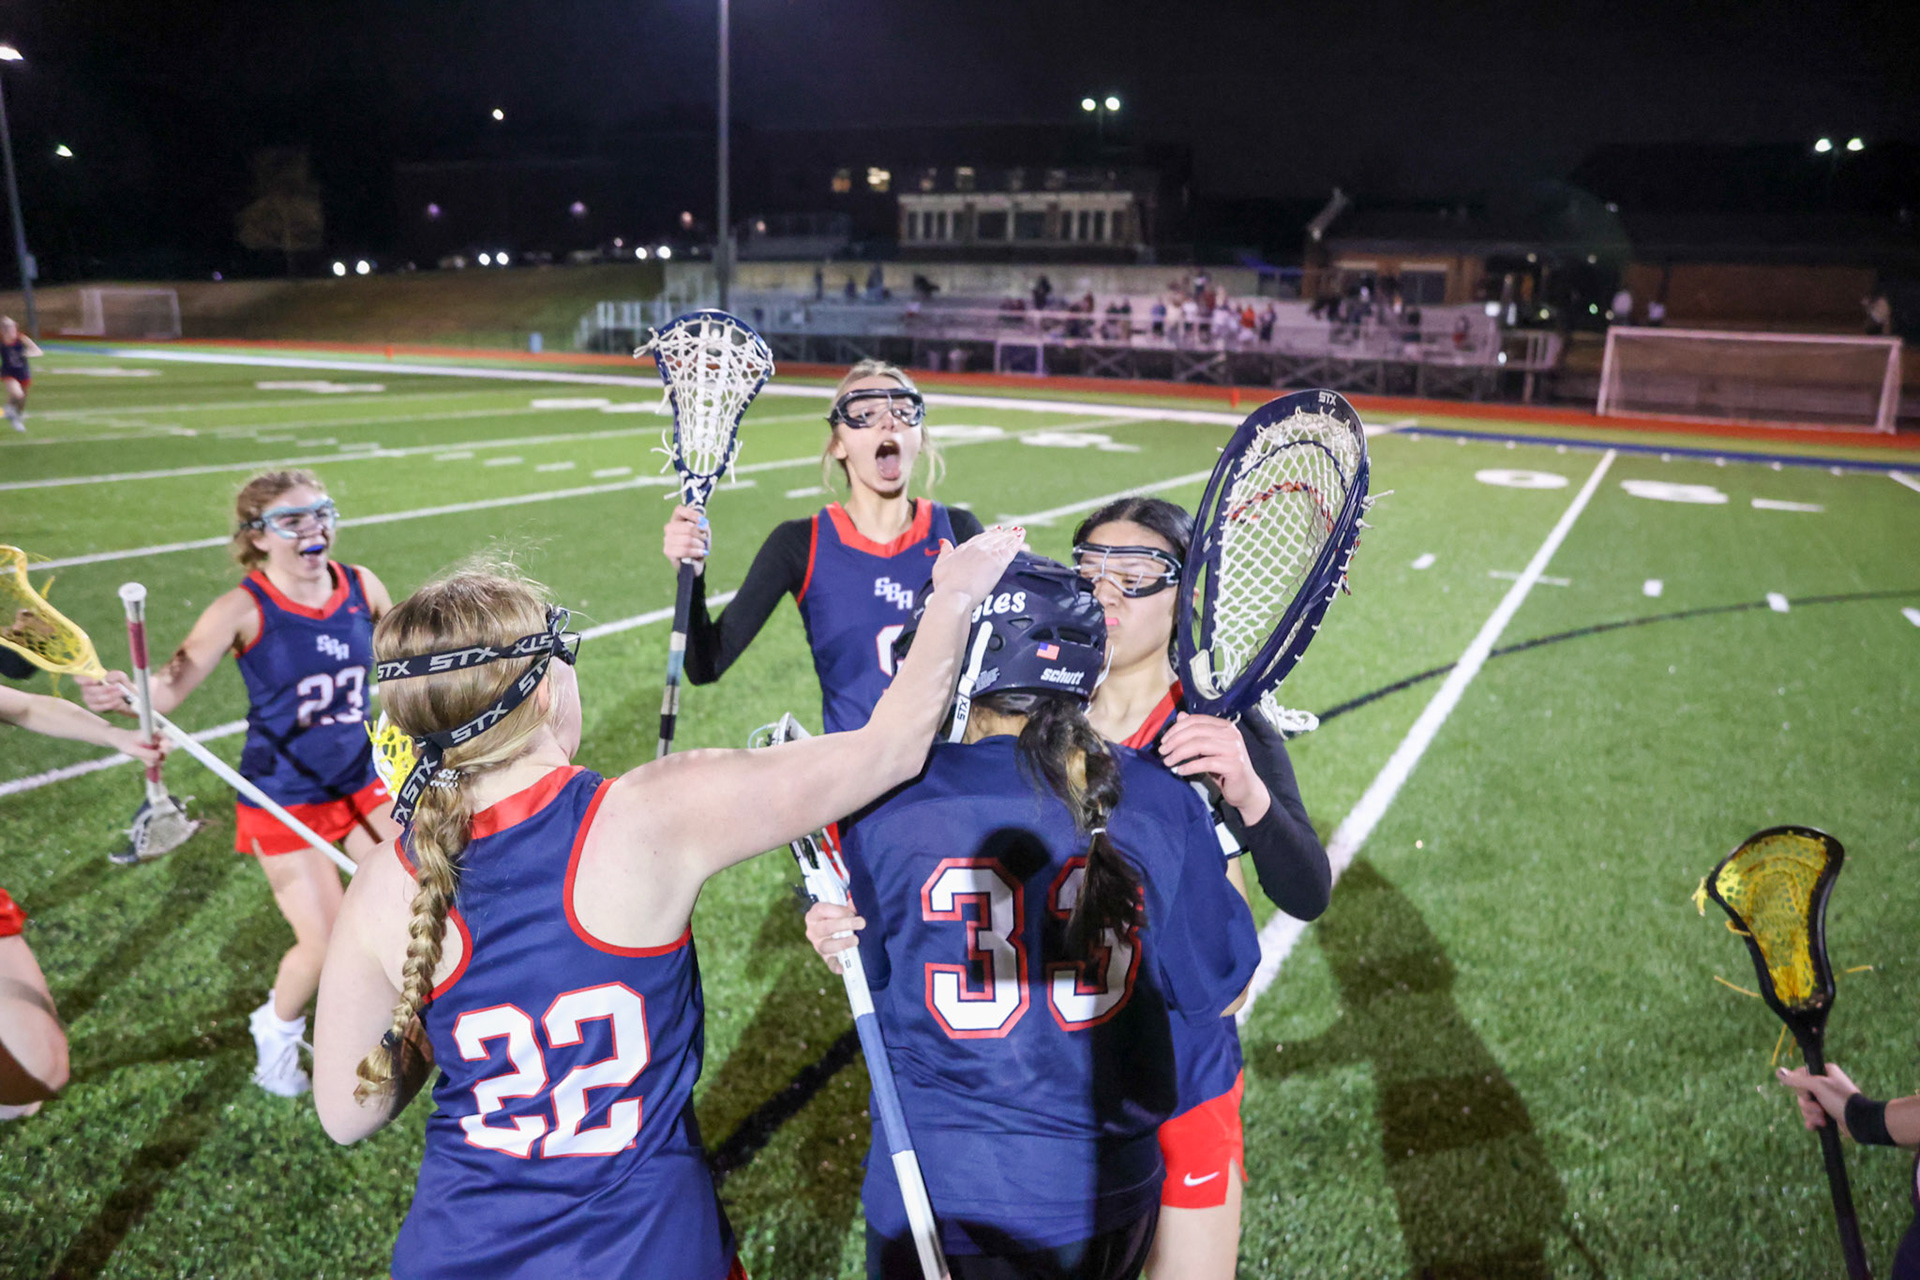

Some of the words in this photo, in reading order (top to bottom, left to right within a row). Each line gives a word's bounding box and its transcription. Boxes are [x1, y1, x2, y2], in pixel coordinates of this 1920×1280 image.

[1318, 391, 1337, 406] STX
[874, 577, 914, 610] SBA
[428, 646, 500, 672] STX
[518, 655, 549, 697] ST
[296, 665, 366, 728] 23
[451, 701, 509, 744] STX
[401, 756, 438, 804] STX
[921, 857, 1142, 1040] 33
[452, 981, 651, 1160] 22
